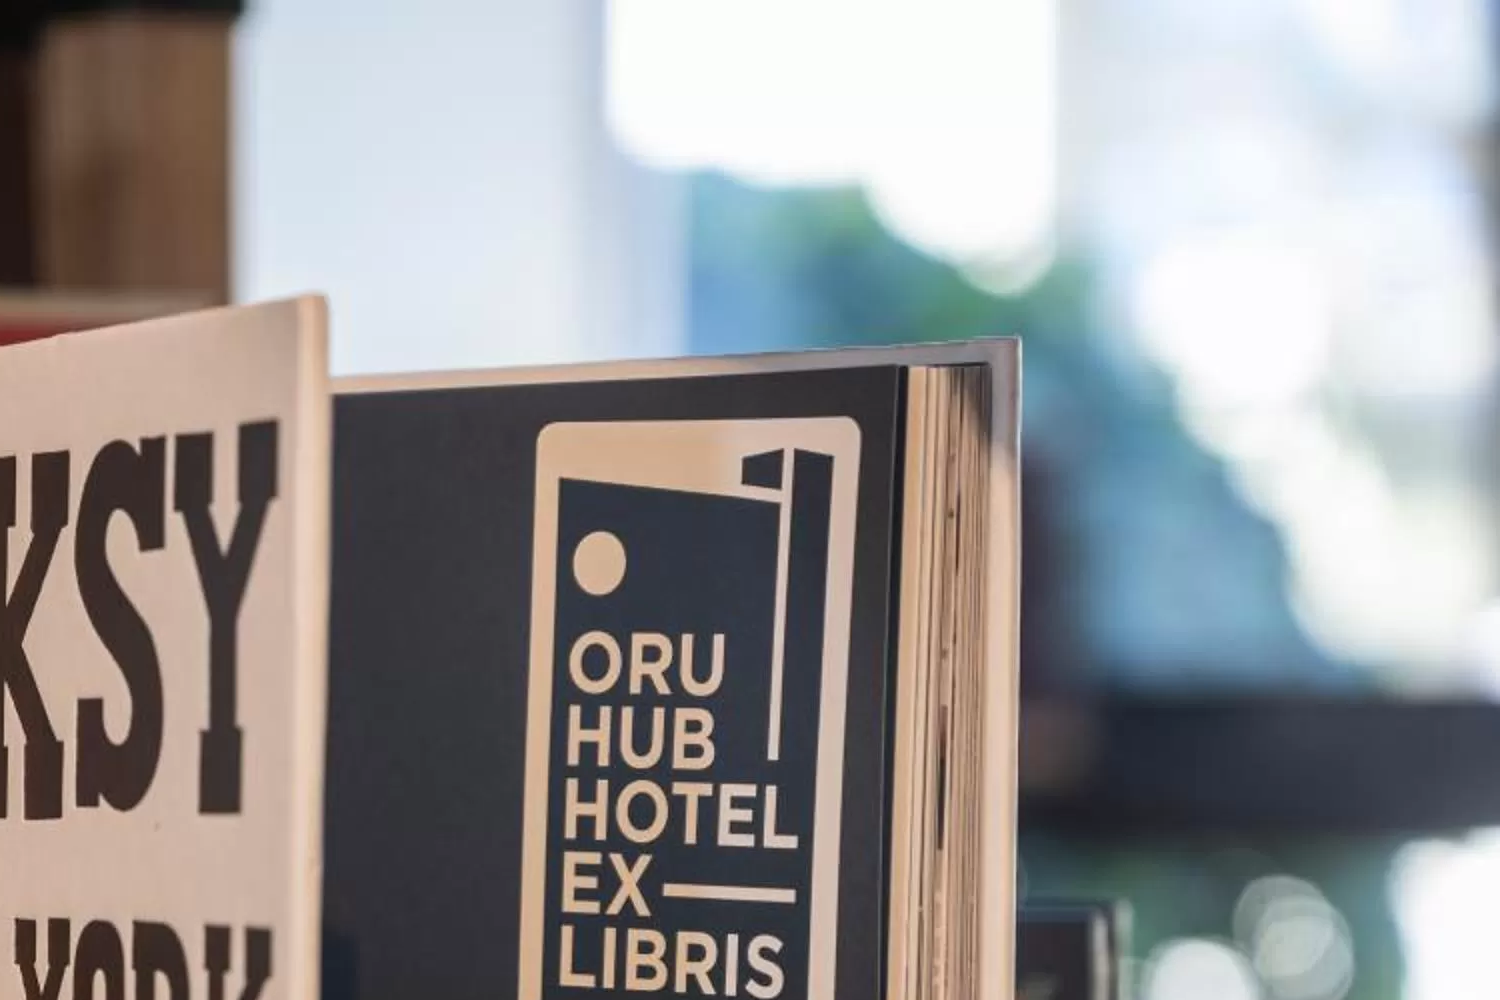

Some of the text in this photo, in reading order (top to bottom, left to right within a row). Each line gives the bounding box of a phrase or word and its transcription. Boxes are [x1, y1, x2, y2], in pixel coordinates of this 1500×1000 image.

[568, 630, 725, 697] ORU
[566, 705, 715, 771] HUB
[563, 777, 799, 849] HOTEL
[561, 851, 652, 916] EX
[558, 924, 785, 1000] LIBRIS
